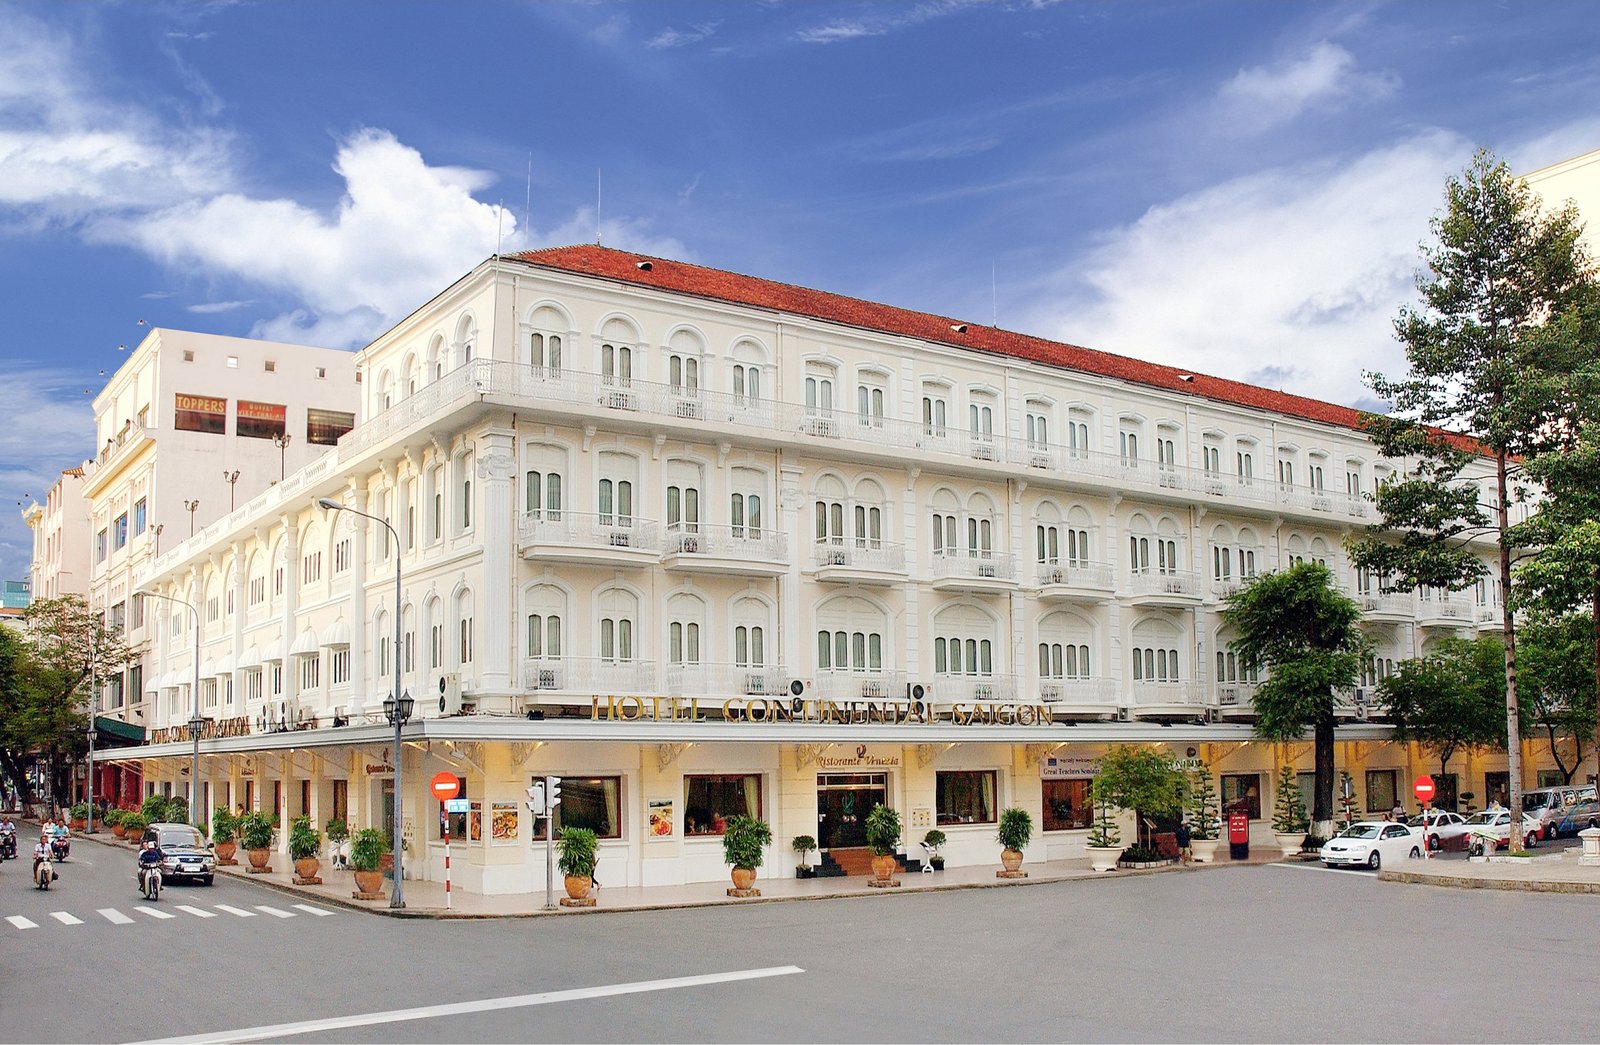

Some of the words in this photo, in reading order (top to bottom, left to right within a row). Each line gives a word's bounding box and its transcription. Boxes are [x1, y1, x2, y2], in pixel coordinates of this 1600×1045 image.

[176, 396, 225, 413] TOPPERS
[591, 694, 706, 723] HOTEL
[722, 697, 940, 725] CONTINENTAL
[951, 702, 1054, 726] SAIGON
[815, 755, 862, 768] Ristorante
[864, 754, 899, 766] Venezia
[1043, 767, 1058, 776] Great
